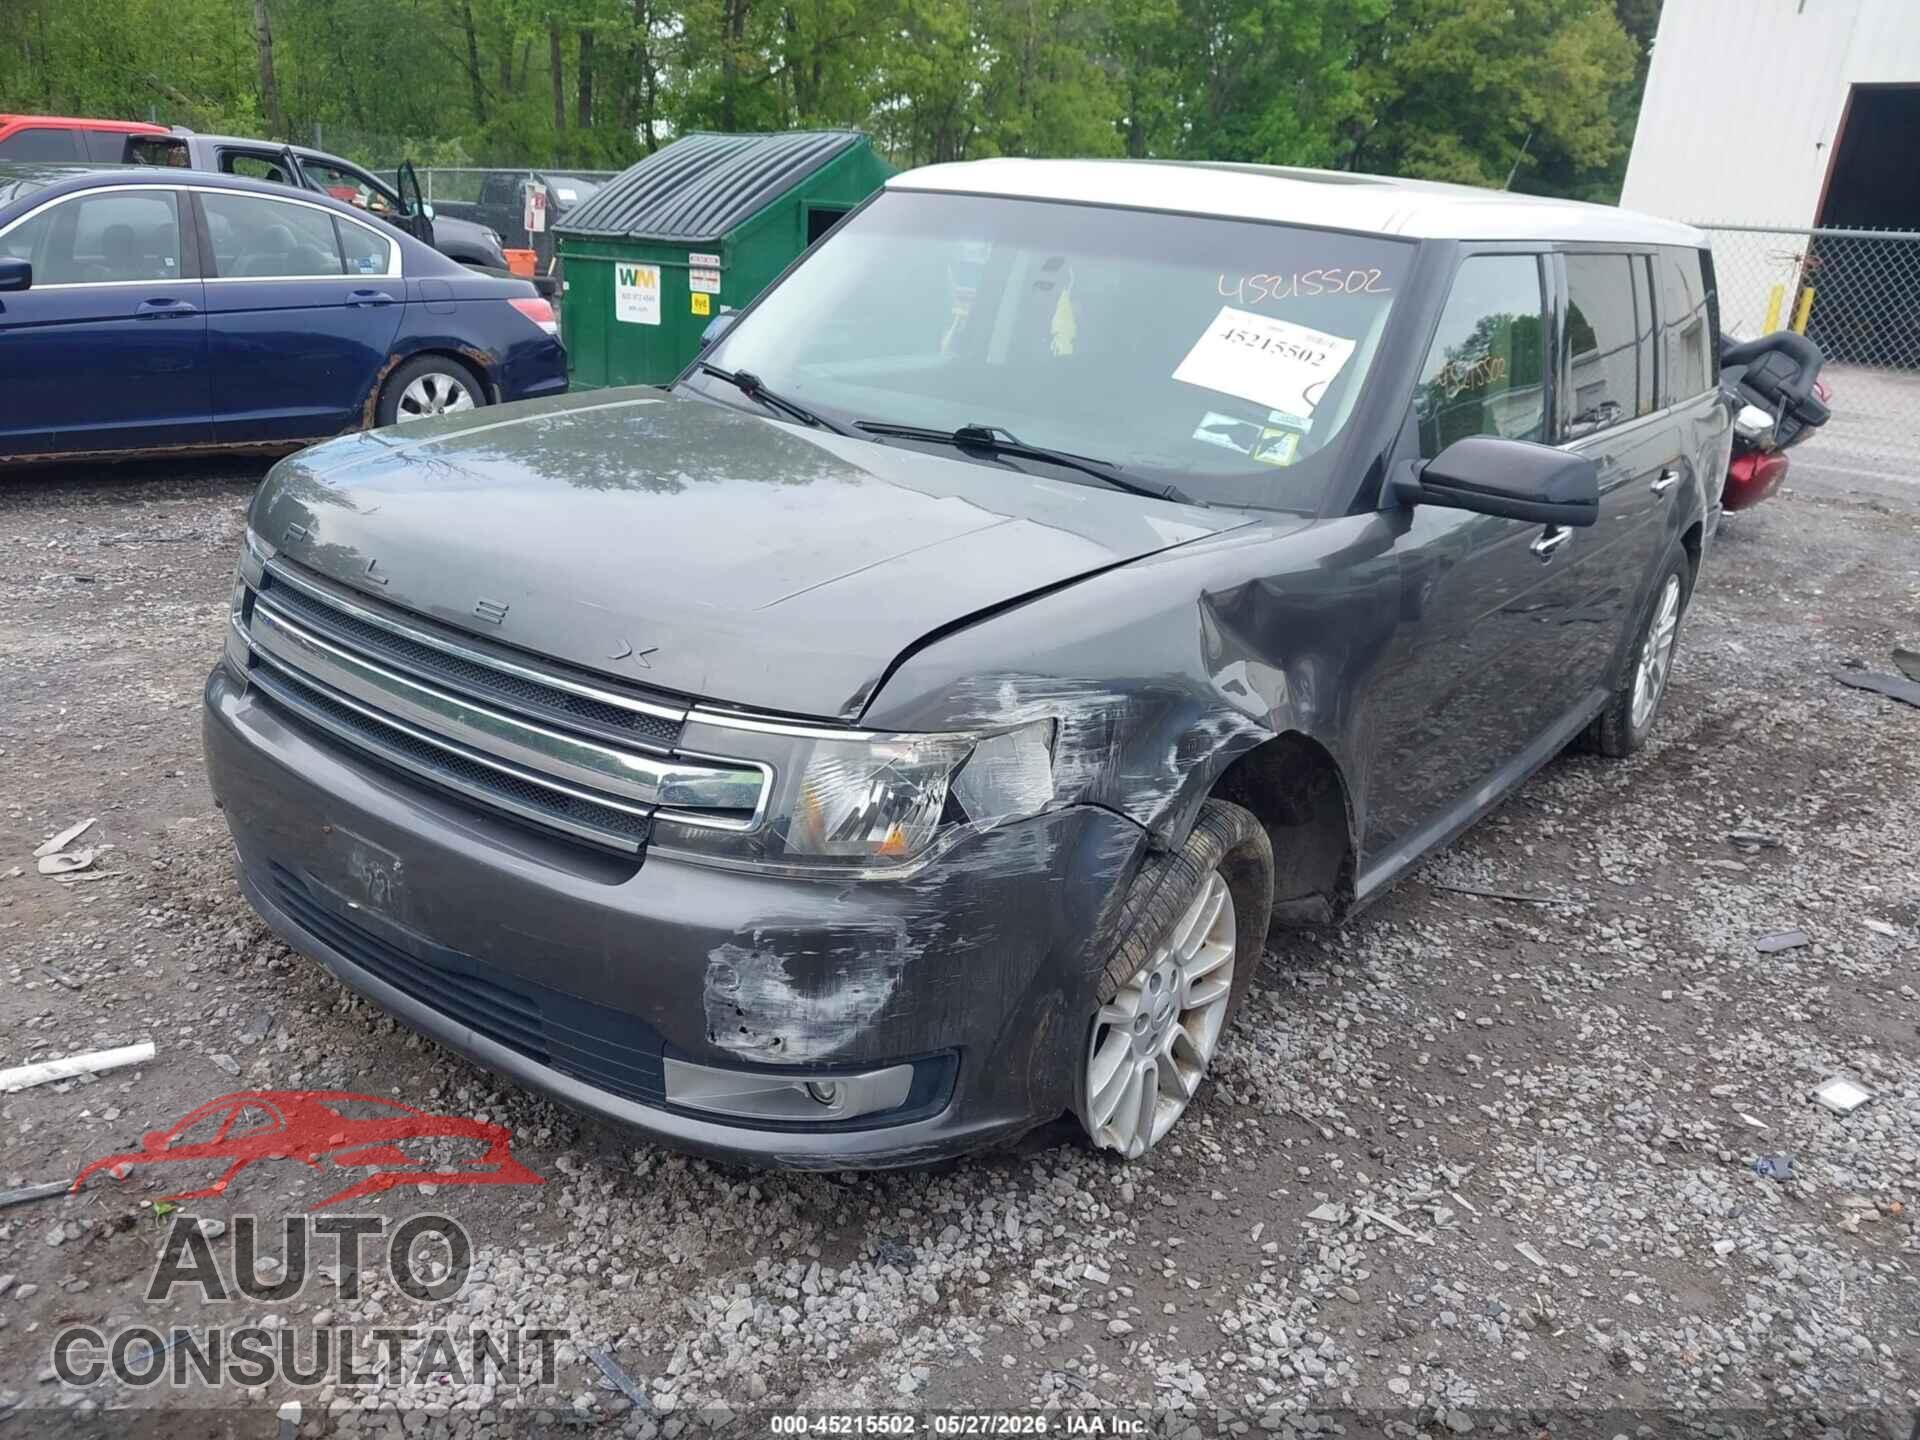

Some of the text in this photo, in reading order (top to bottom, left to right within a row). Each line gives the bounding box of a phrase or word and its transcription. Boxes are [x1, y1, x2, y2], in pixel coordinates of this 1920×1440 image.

[619, 267, 657, 289] WM
[1216, 268, 1392, 304] 45215502
[1219, 327, 1327, 367] 45215502
